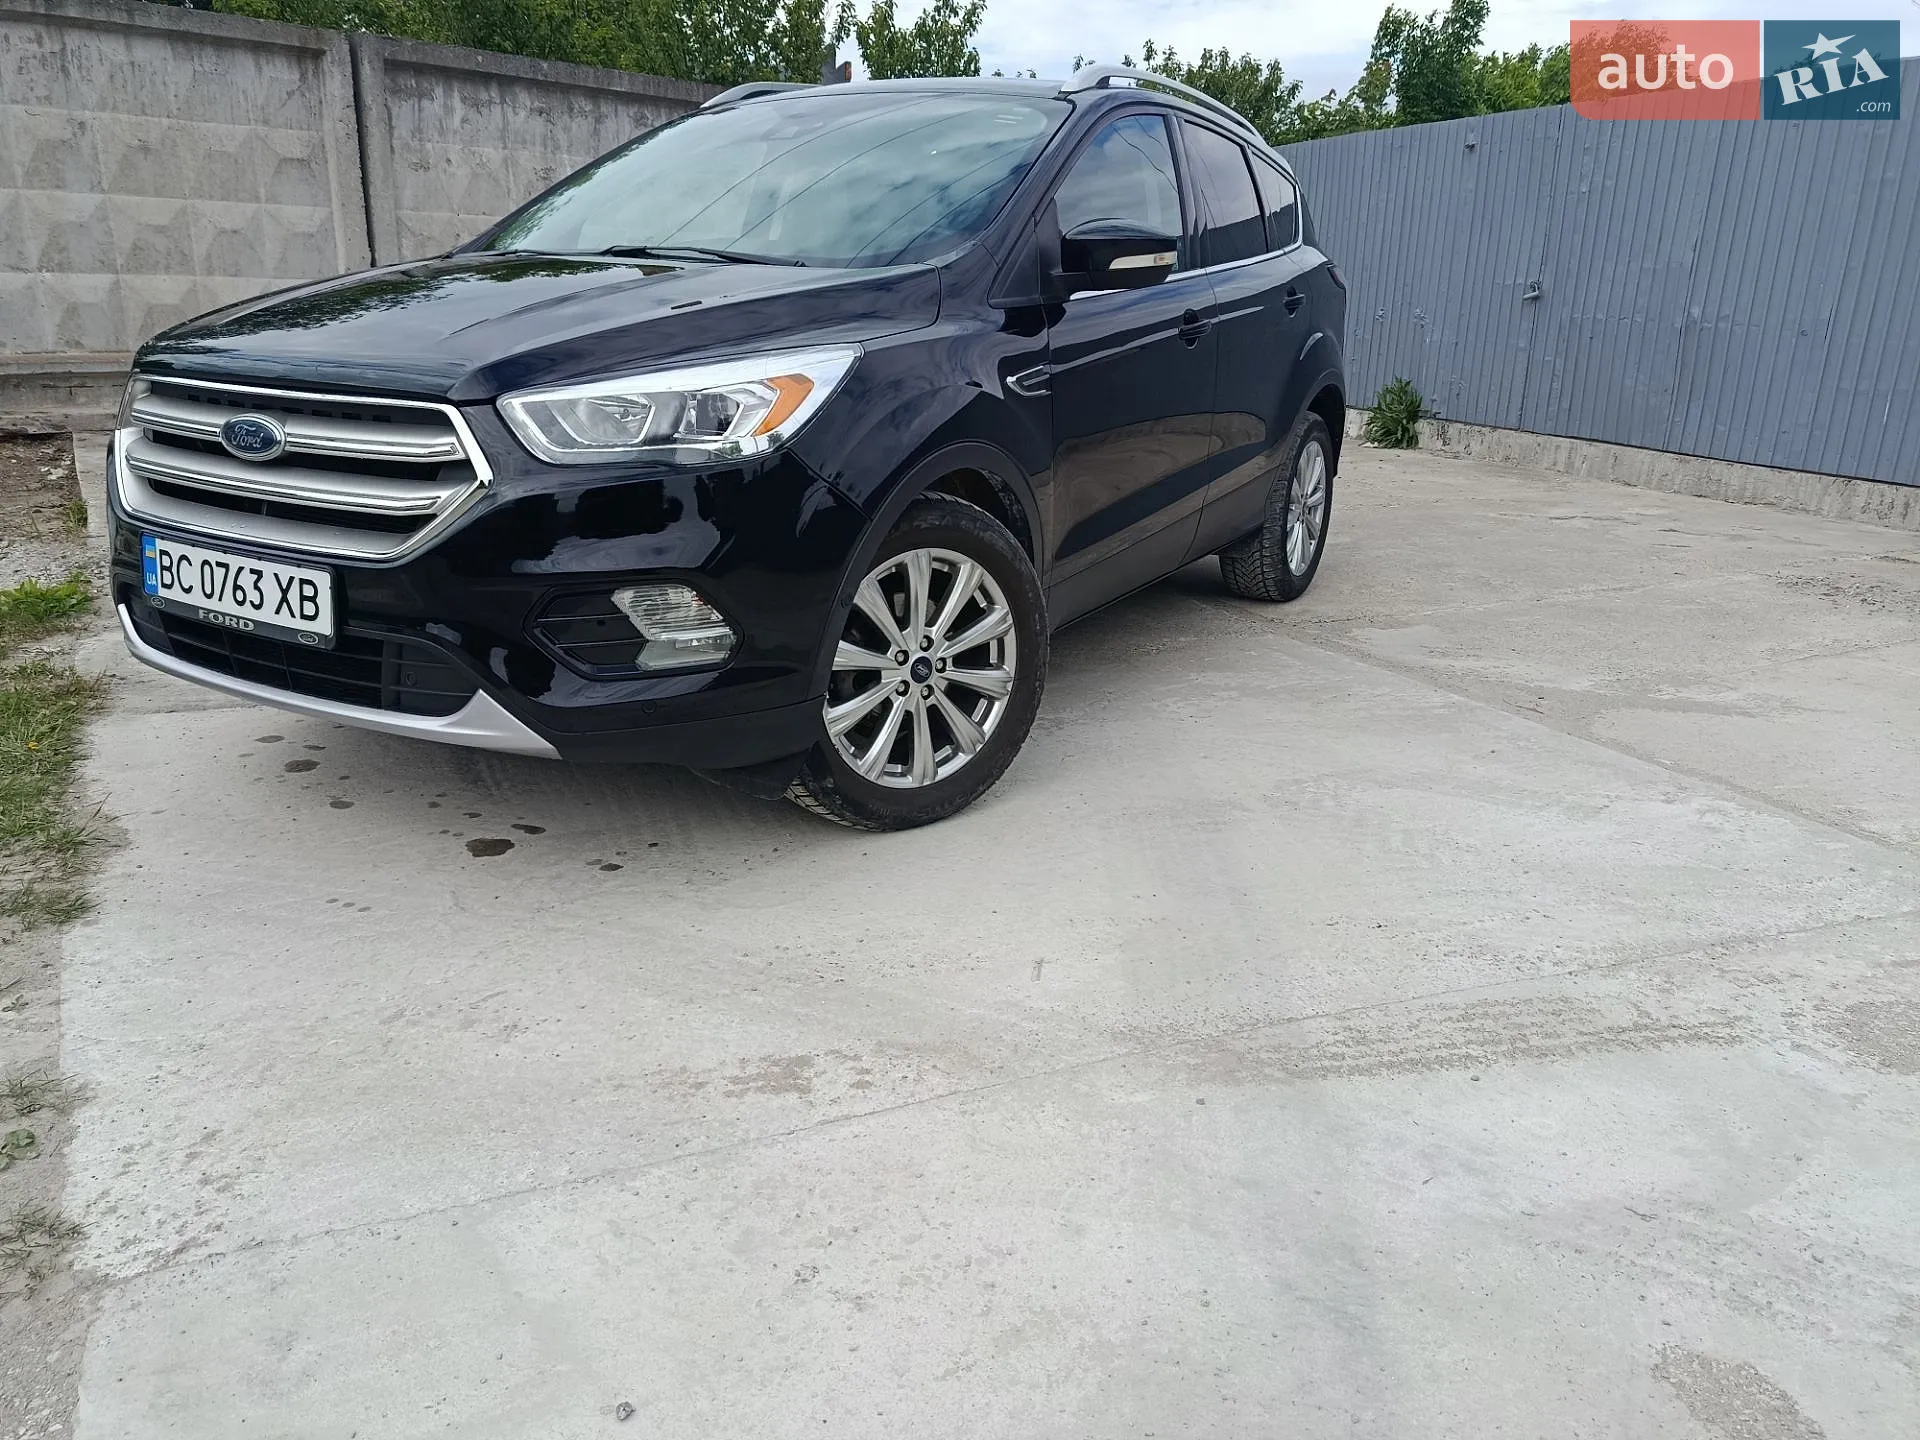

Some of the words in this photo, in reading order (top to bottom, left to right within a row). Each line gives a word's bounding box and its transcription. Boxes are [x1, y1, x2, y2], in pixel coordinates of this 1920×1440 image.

[231, 423, 264, 448] Ford
[146, 572, 158, 586] UA
[159, 549, 194, 594] BC
[200, 559, 264, 611] 0763
[273, 572, 320, 622] XB
[198, 609, 255, 631] FORD
